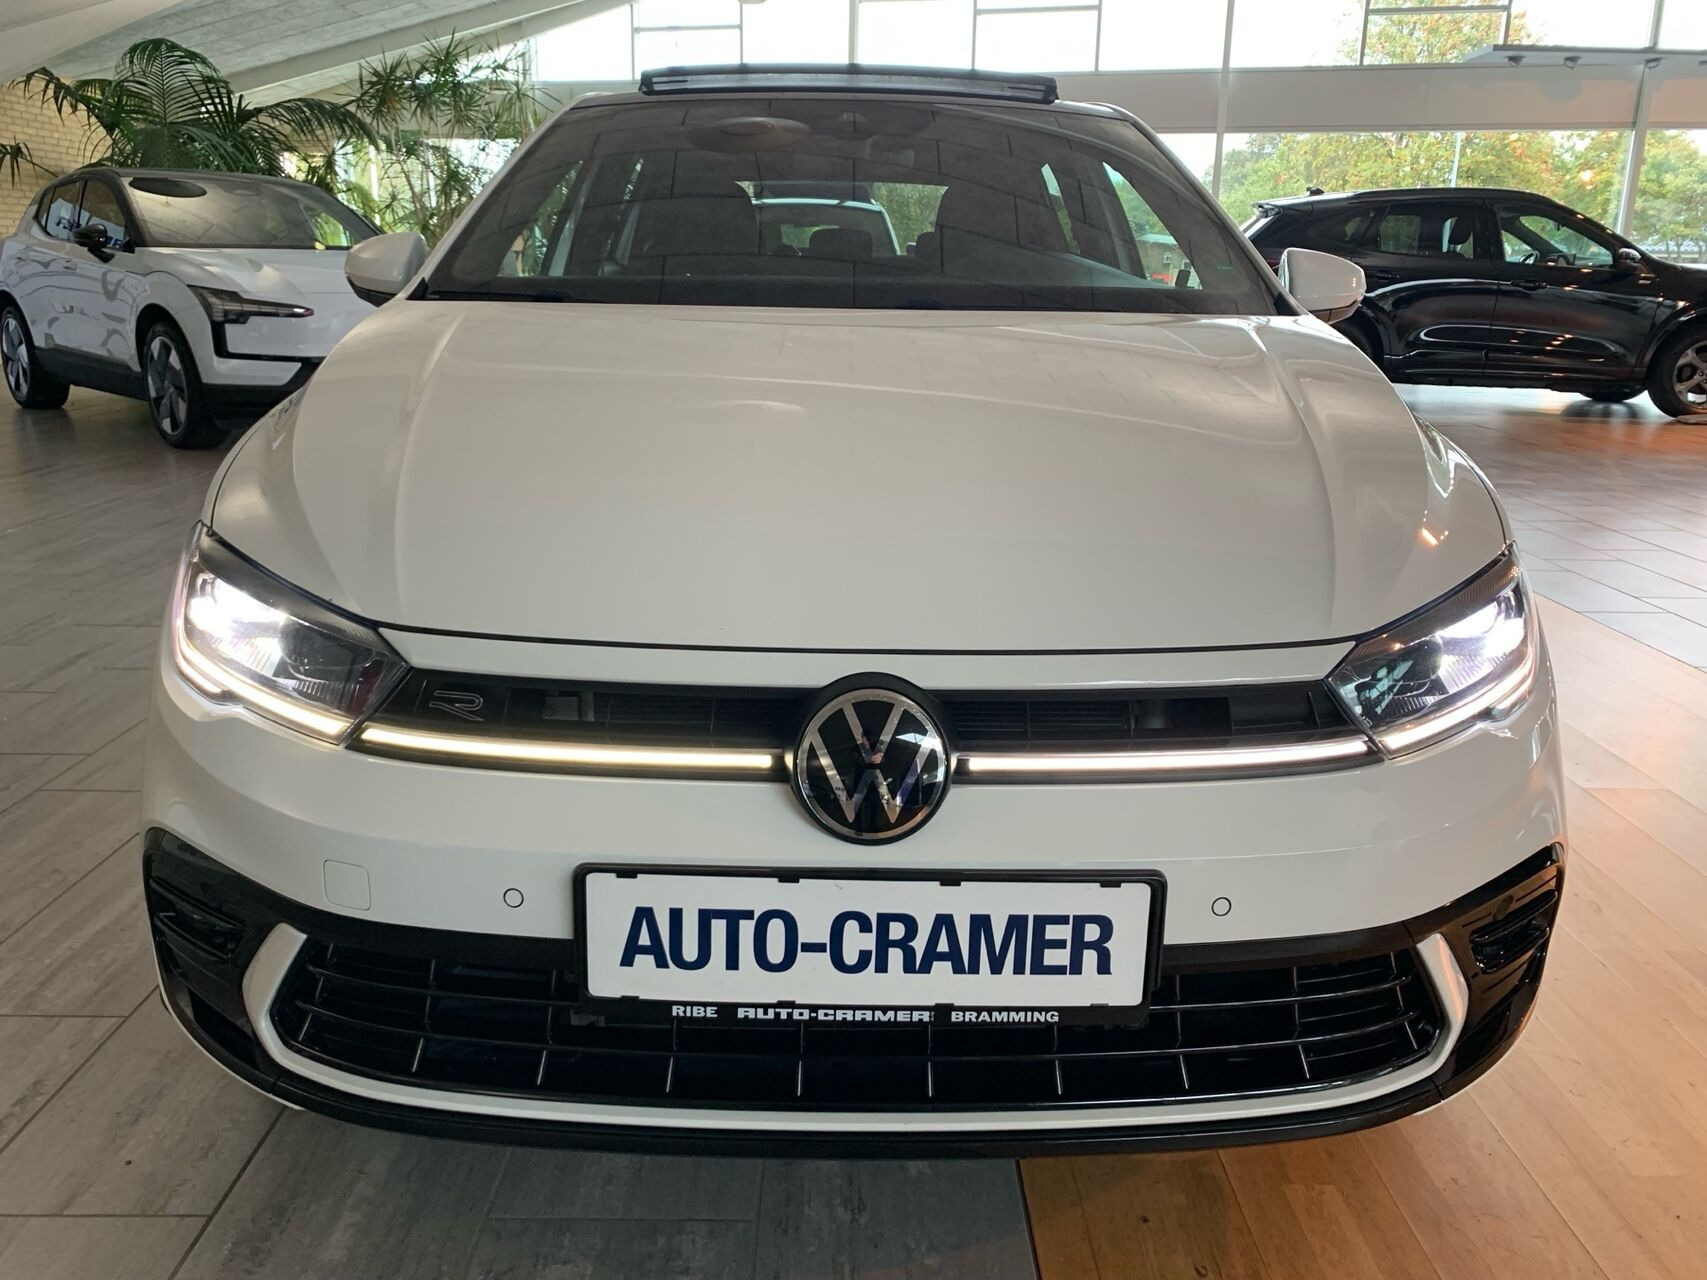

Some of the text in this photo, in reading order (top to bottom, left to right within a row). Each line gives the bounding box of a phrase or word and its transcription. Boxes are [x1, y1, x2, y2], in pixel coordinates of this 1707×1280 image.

[619, 906, 1114, 976] AUTO-CRAMER
[671, 1005, 718, 1018] RIBE
[737, 1008, 930, 1022] AUTO-CRAMER
[951, 1011, 1060, 1023] BRAMMING
